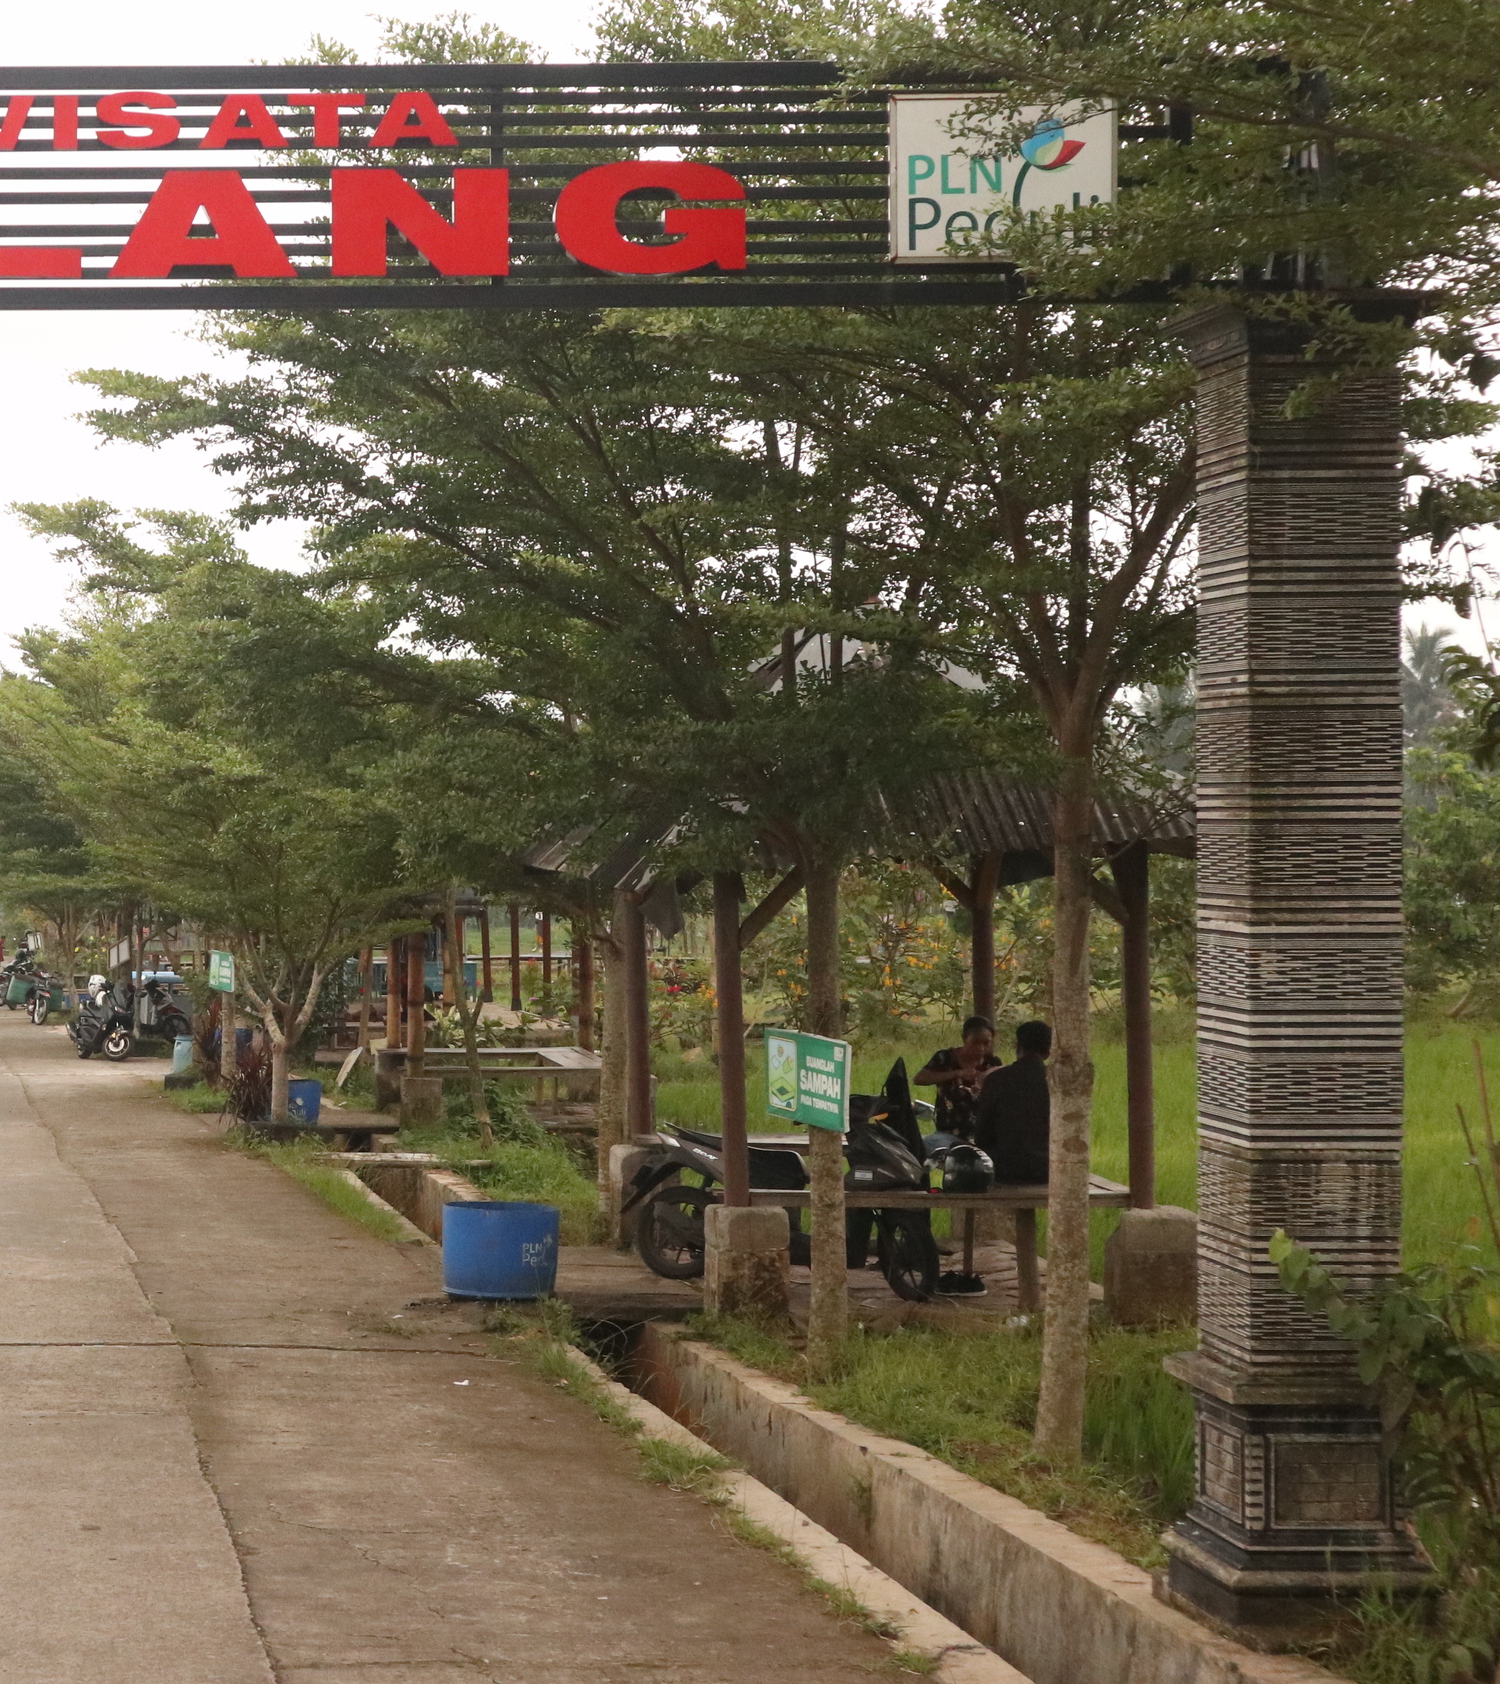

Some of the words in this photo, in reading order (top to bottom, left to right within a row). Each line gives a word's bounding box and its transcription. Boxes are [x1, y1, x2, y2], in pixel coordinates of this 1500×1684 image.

[907, 154, 1003, 195] PLN
[799, 1068, 841, 1099] SAMPAH
[522, 1242, 543, 1254] PLN
